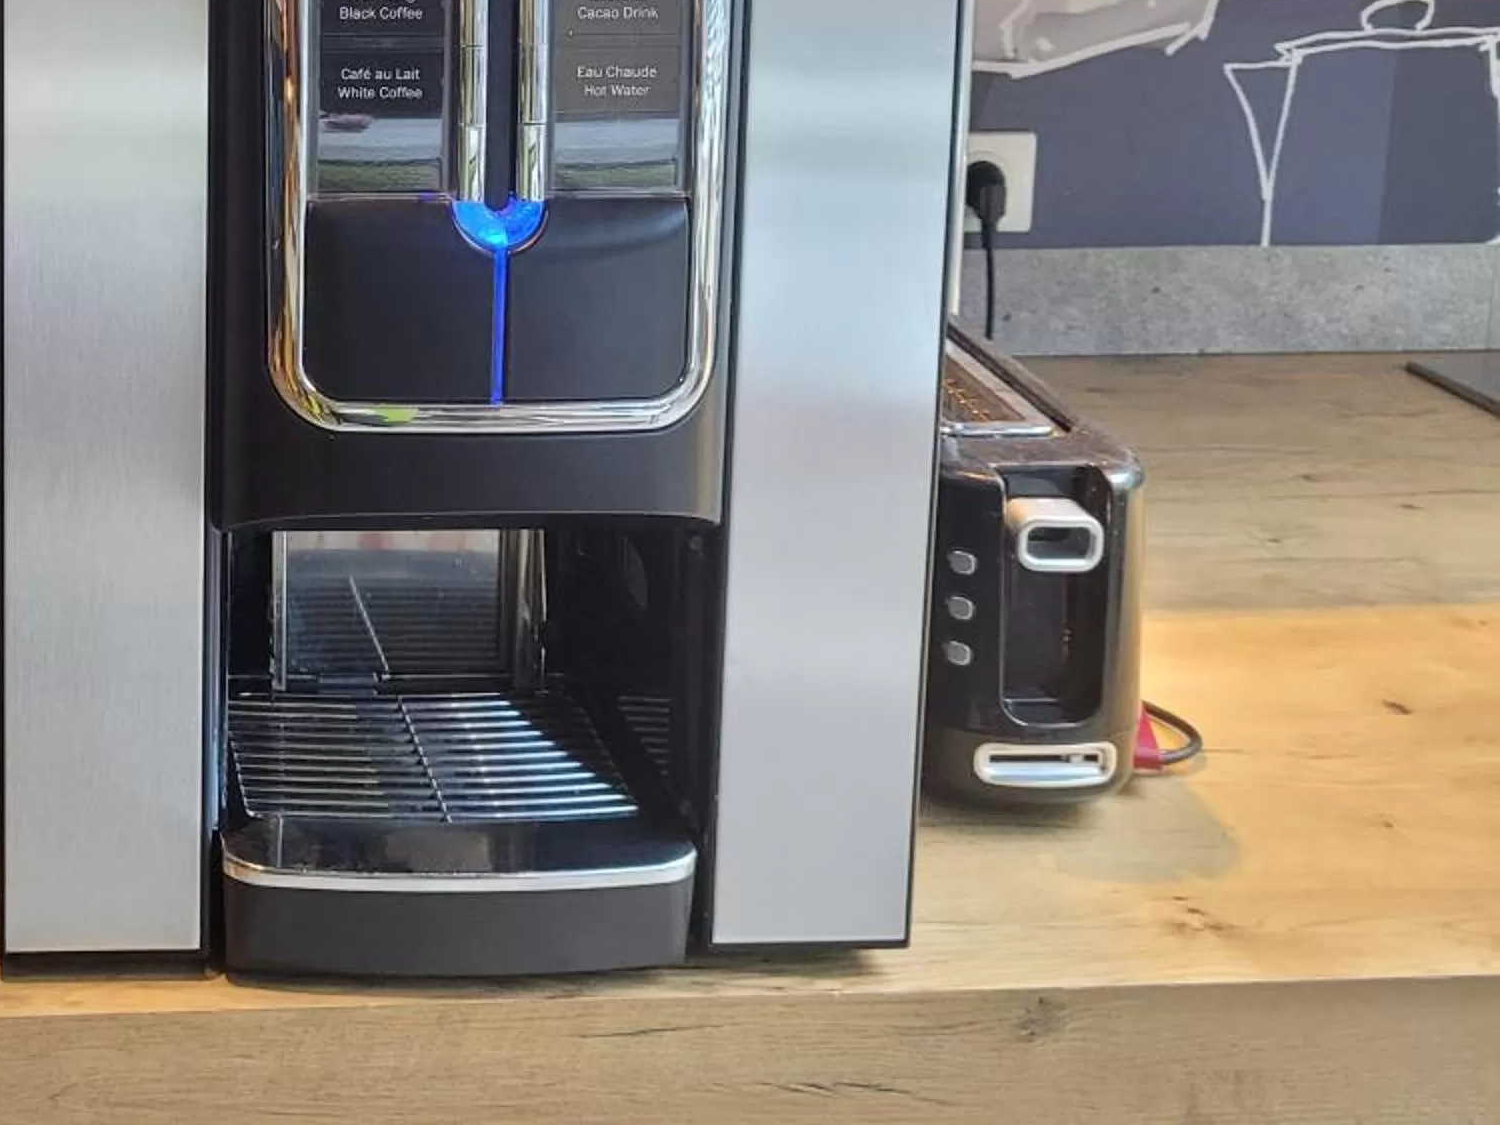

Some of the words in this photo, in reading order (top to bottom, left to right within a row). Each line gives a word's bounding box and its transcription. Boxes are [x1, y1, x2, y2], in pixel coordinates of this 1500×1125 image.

[340, 6, 375, 19] Black
[378, 6, 423, 19] Coffee
[578, 8, 619, 19] Cacao
[624, 6, 659, 19] Drink
[341, 67, 371, 80] Café
[375, 70, 391, 80] au
[395, 67, 420, 80] Lait
[577, 66, 603, 79] Eau
[607, 65, 657, 79] Chaude
[338, 86, 374, 99] White
[378, 86, 423, 99] Coffee
[584, 84, 606, 97] Hot
[610, 85, 650, 97] Water
